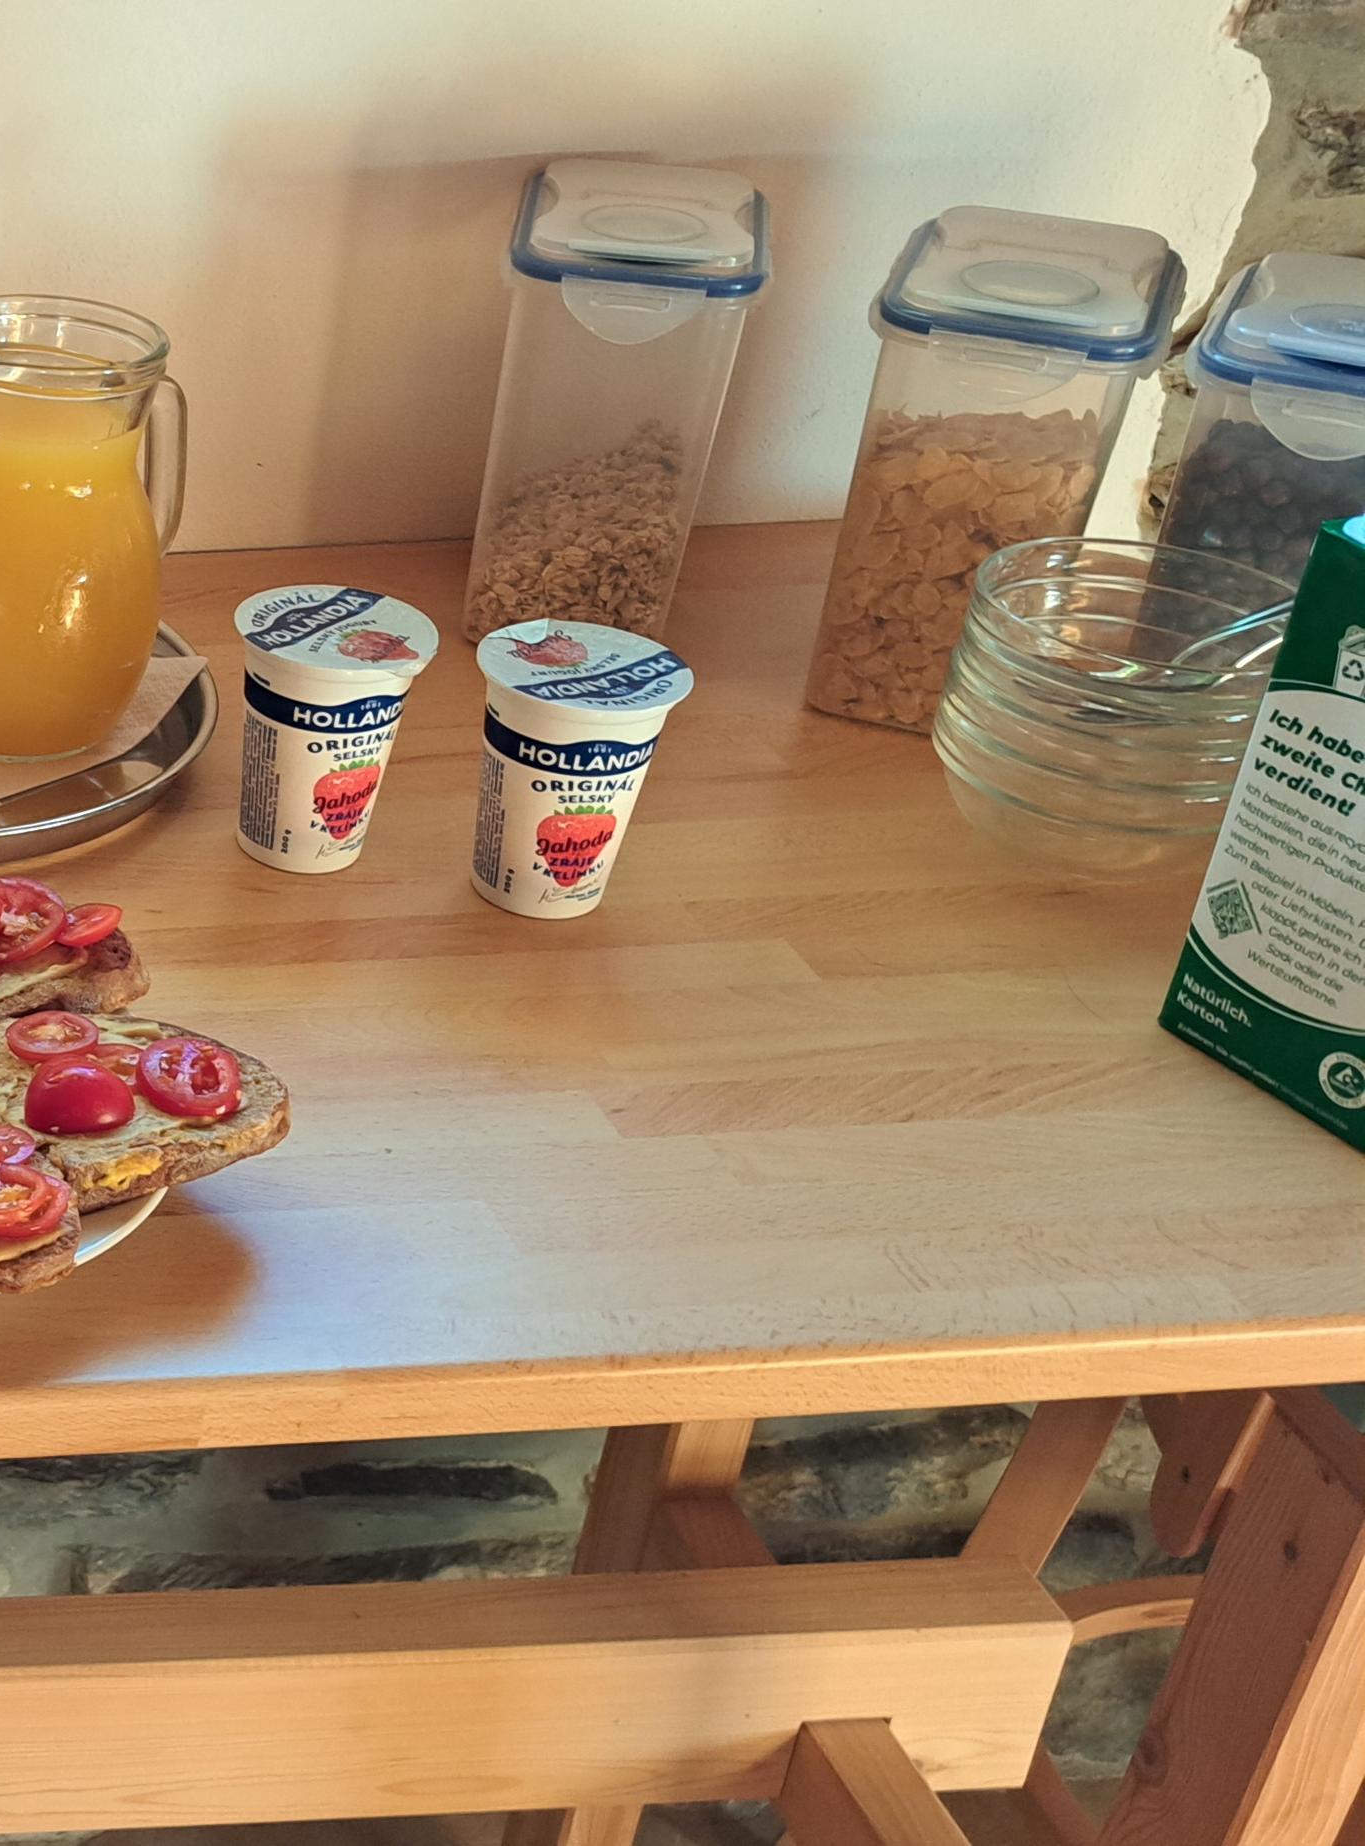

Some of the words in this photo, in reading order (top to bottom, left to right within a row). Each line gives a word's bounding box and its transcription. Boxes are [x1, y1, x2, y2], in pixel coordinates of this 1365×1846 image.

[251, 592, 321, 627] ORIGINÁL
[253, 595, 368, 647] HOLLANDIA
[529, 657, 678, 697] HOLLANDIA
[582, 679, 674, 706] ORIGINÁL
[333, 743, 382, 763] SELSKÝ
[1269, 709, 1303, 735] Ich
[1307, 725, 1365, 765] habe
[1260, 734, 1335, 779] zweite
[312, 780, 378, 815] Jahoda
[530, 774, 635, 792] ORIGINÁL
[557, 790, 614, 804] SELSKÝ
[1254, 756, 1357, 818] verdient!
[1240, 798, 1305, 842] Materialien,
[1307, 836, 1330, 853] die
[1245, 782, 1262, 799] Ich
[1263, 792, 1310, 824] bestehe
[1310, 819, 1334, 836] aus
[535, 830, 614, 856] Jahoda
[1230, 829, 1270, 860] werden.
[1235, 813, 1312, 863] hochwertigen
[532, 862, 543, 871] V
[549, 855, 596, 867] ZRAJE
[1224, 843, 1249, 866] Zum
[1249, 860, 1296, 891] Beispiel
[504, 876, 513, 894] 200
[1251, 880, 1281, 900] oder
[1269, 925, 1326, 966] Gebrauch
[1342, 948, 1362, 966] ich
[1267, 942, 1293, 967] Sack
[1293, 960, 1324, 982] oder
[1323, 975, 1344, 993] die
[1176, 988, 1229, 1033] Karton.
[1182, 972, 1253, 1028] Natürlich.
